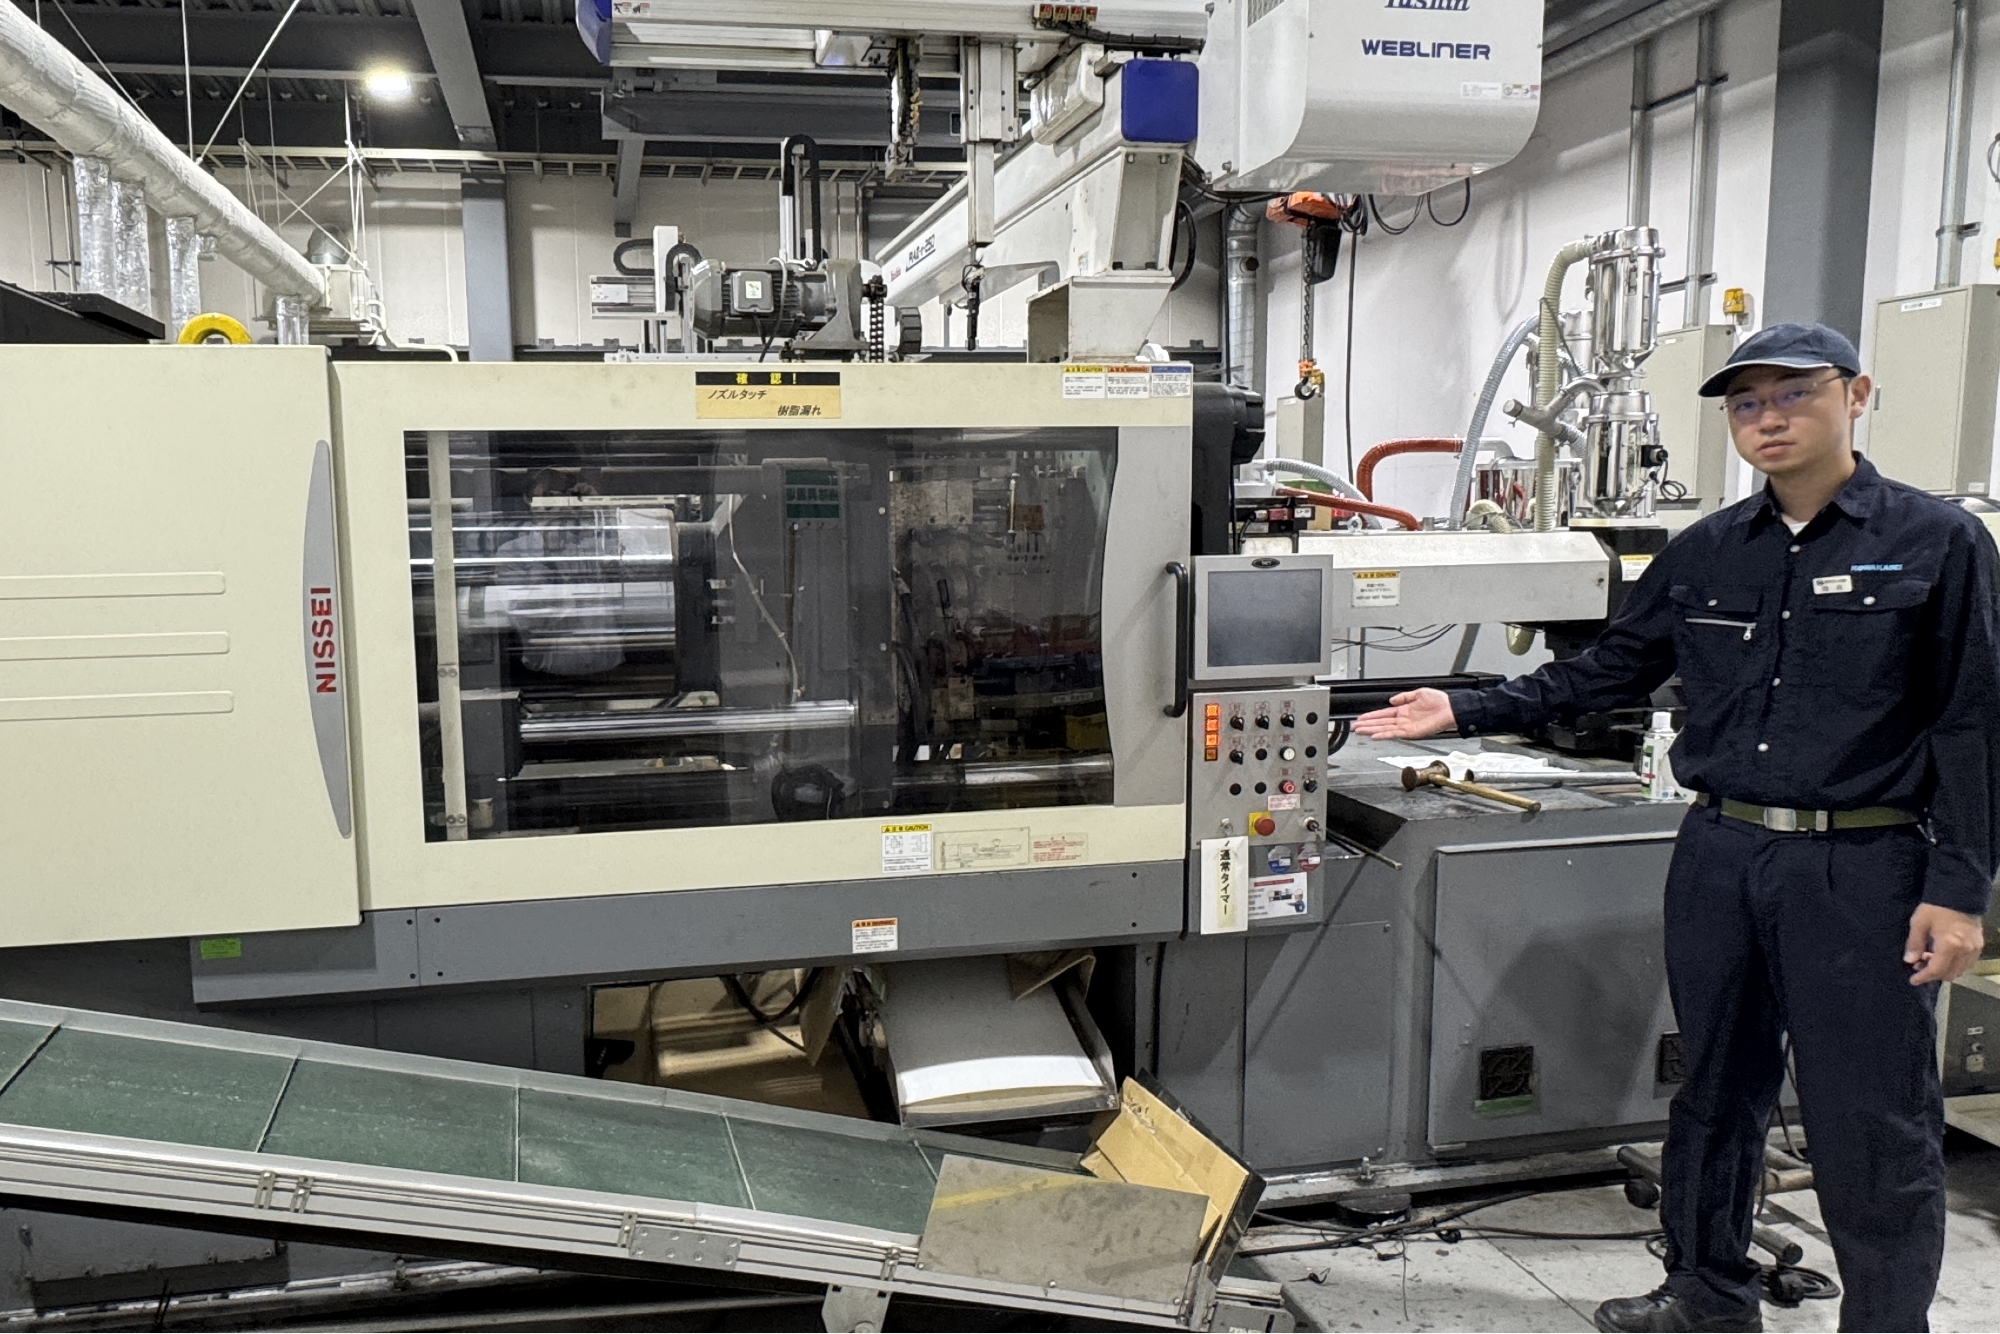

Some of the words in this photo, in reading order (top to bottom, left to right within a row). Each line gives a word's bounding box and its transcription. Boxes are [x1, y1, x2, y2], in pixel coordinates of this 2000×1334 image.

[1361, 39, 1491, 60] WEBLINER
[707, 389, 767, 400] ノズルタッチ
[777, 405, 821, 416] 樹脂漏れ
[310, 587, 337, 693] NISSEI
[1220, 849, 1231, 915] 通常タイマー
